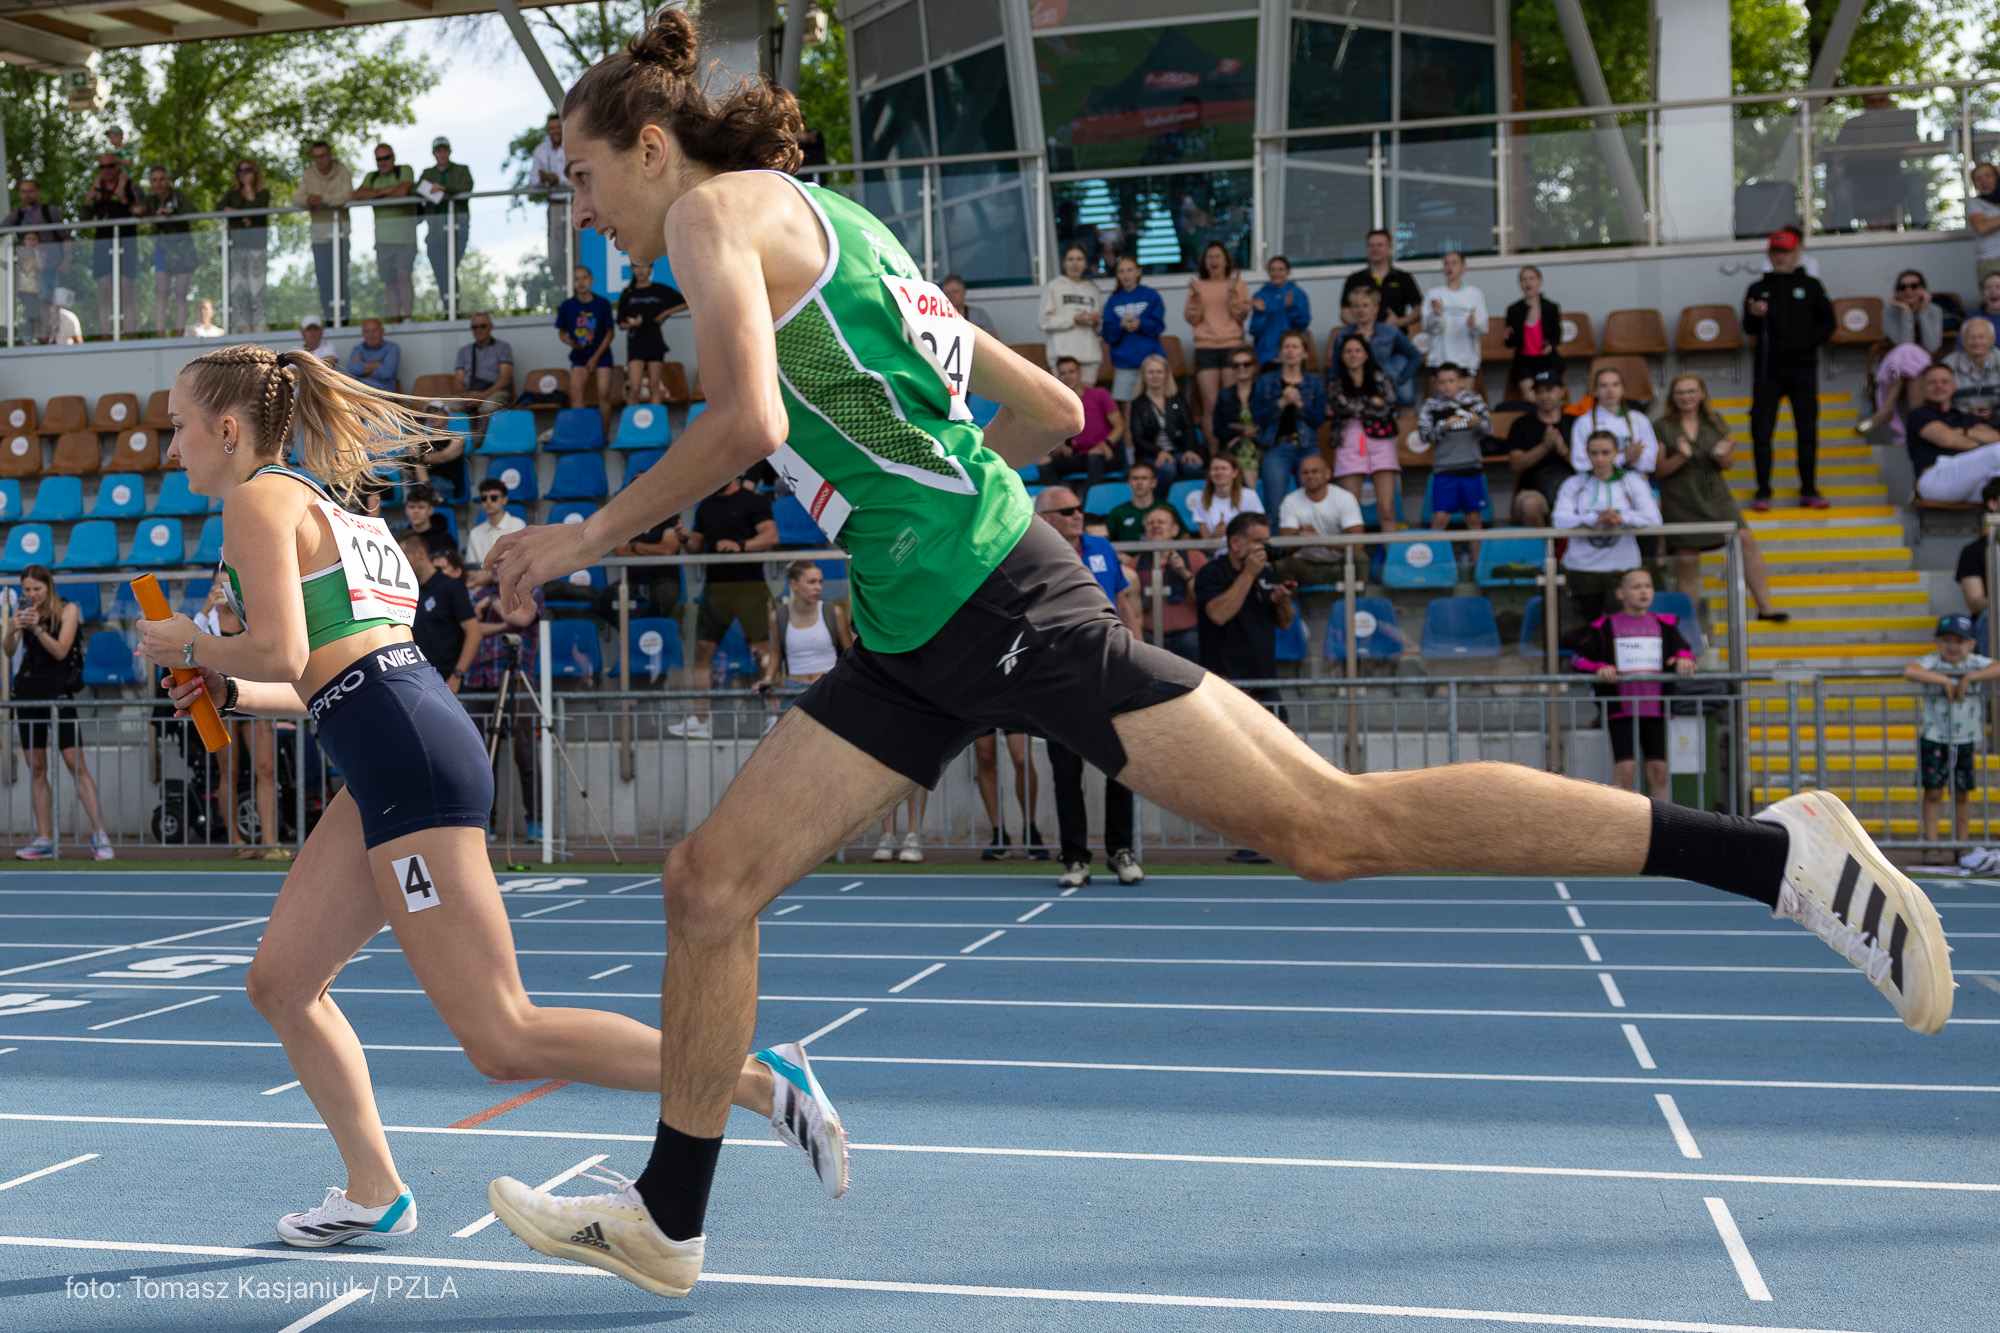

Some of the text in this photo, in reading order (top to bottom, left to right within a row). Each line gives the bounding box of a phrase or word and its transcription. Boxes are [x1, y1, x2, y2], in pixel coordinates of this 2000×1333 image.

[351, 536, 411, 590] 122
[376, 647, 418, 672] NIKE
[313, 669, 365, 719] PRO
[405, 856, 432, 898] 4
[570, 1235, 611, 1251] adidas
